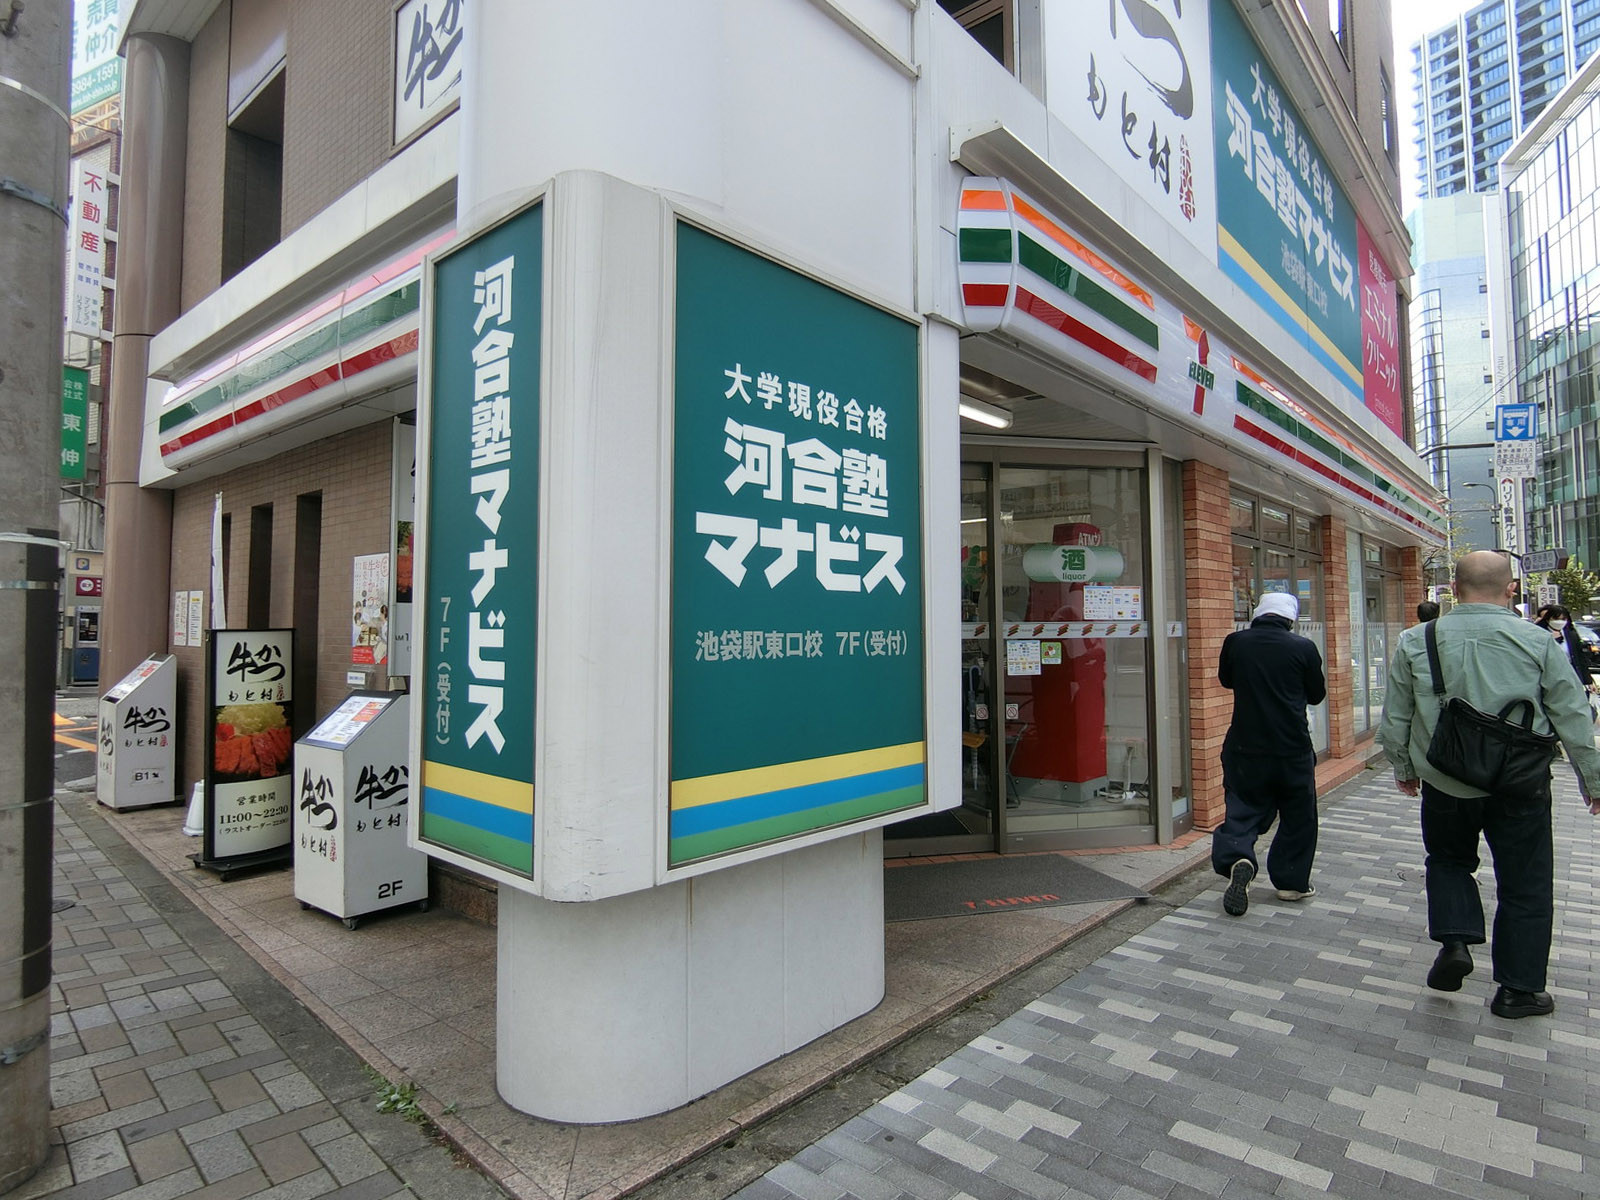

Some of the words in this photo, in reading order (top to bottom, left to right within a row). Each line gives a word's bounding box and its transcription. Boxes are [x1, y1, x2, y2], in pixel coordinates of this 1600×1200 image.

[85, 24, 118, 62] 仲介
[1250, 61, 1334, 223] 大学現役合格
[80, 171, 102, 254] 不動産
[1225, 79, 1356, 313] 河合塾マナビス
[1364, 284, 1395, 349] エミナル
[1366, 333, 1397, 393] クリニック
[723, 362, 888, 441] 大学現役合格
[61, 413, 82, 467] 東伸
[723, 416, 889, 518] 河合塾
[464, 255, 515, 756] 河合塾マナビス
[695, 511, 907, 597] マナビス
[1061, 549, 1086, 571] 酒
[1062, 572, 1086, 580] liquor
[226, 641, 286, 684] 牛かつ
[695, 630, 824, 662] 池袋駅東口校
[836, 630, 908, 657] 7F(受付)
[435, 597, 452, 747] 7F(受付)
[228, 688, 273, 702] もと村
[124, 705, 171, 734] 牛かつ
[124, 736, 158, 748] もと村
[134, 771, 149, 781] B1
[237, 792, 276, 806] 営業時間
[301, 767, 338, 831] 牛かつ
[356, 813, 401, 832] もと村
[301, 832, 328, 857] もと村
[377, 880, 403, 899] 2F
